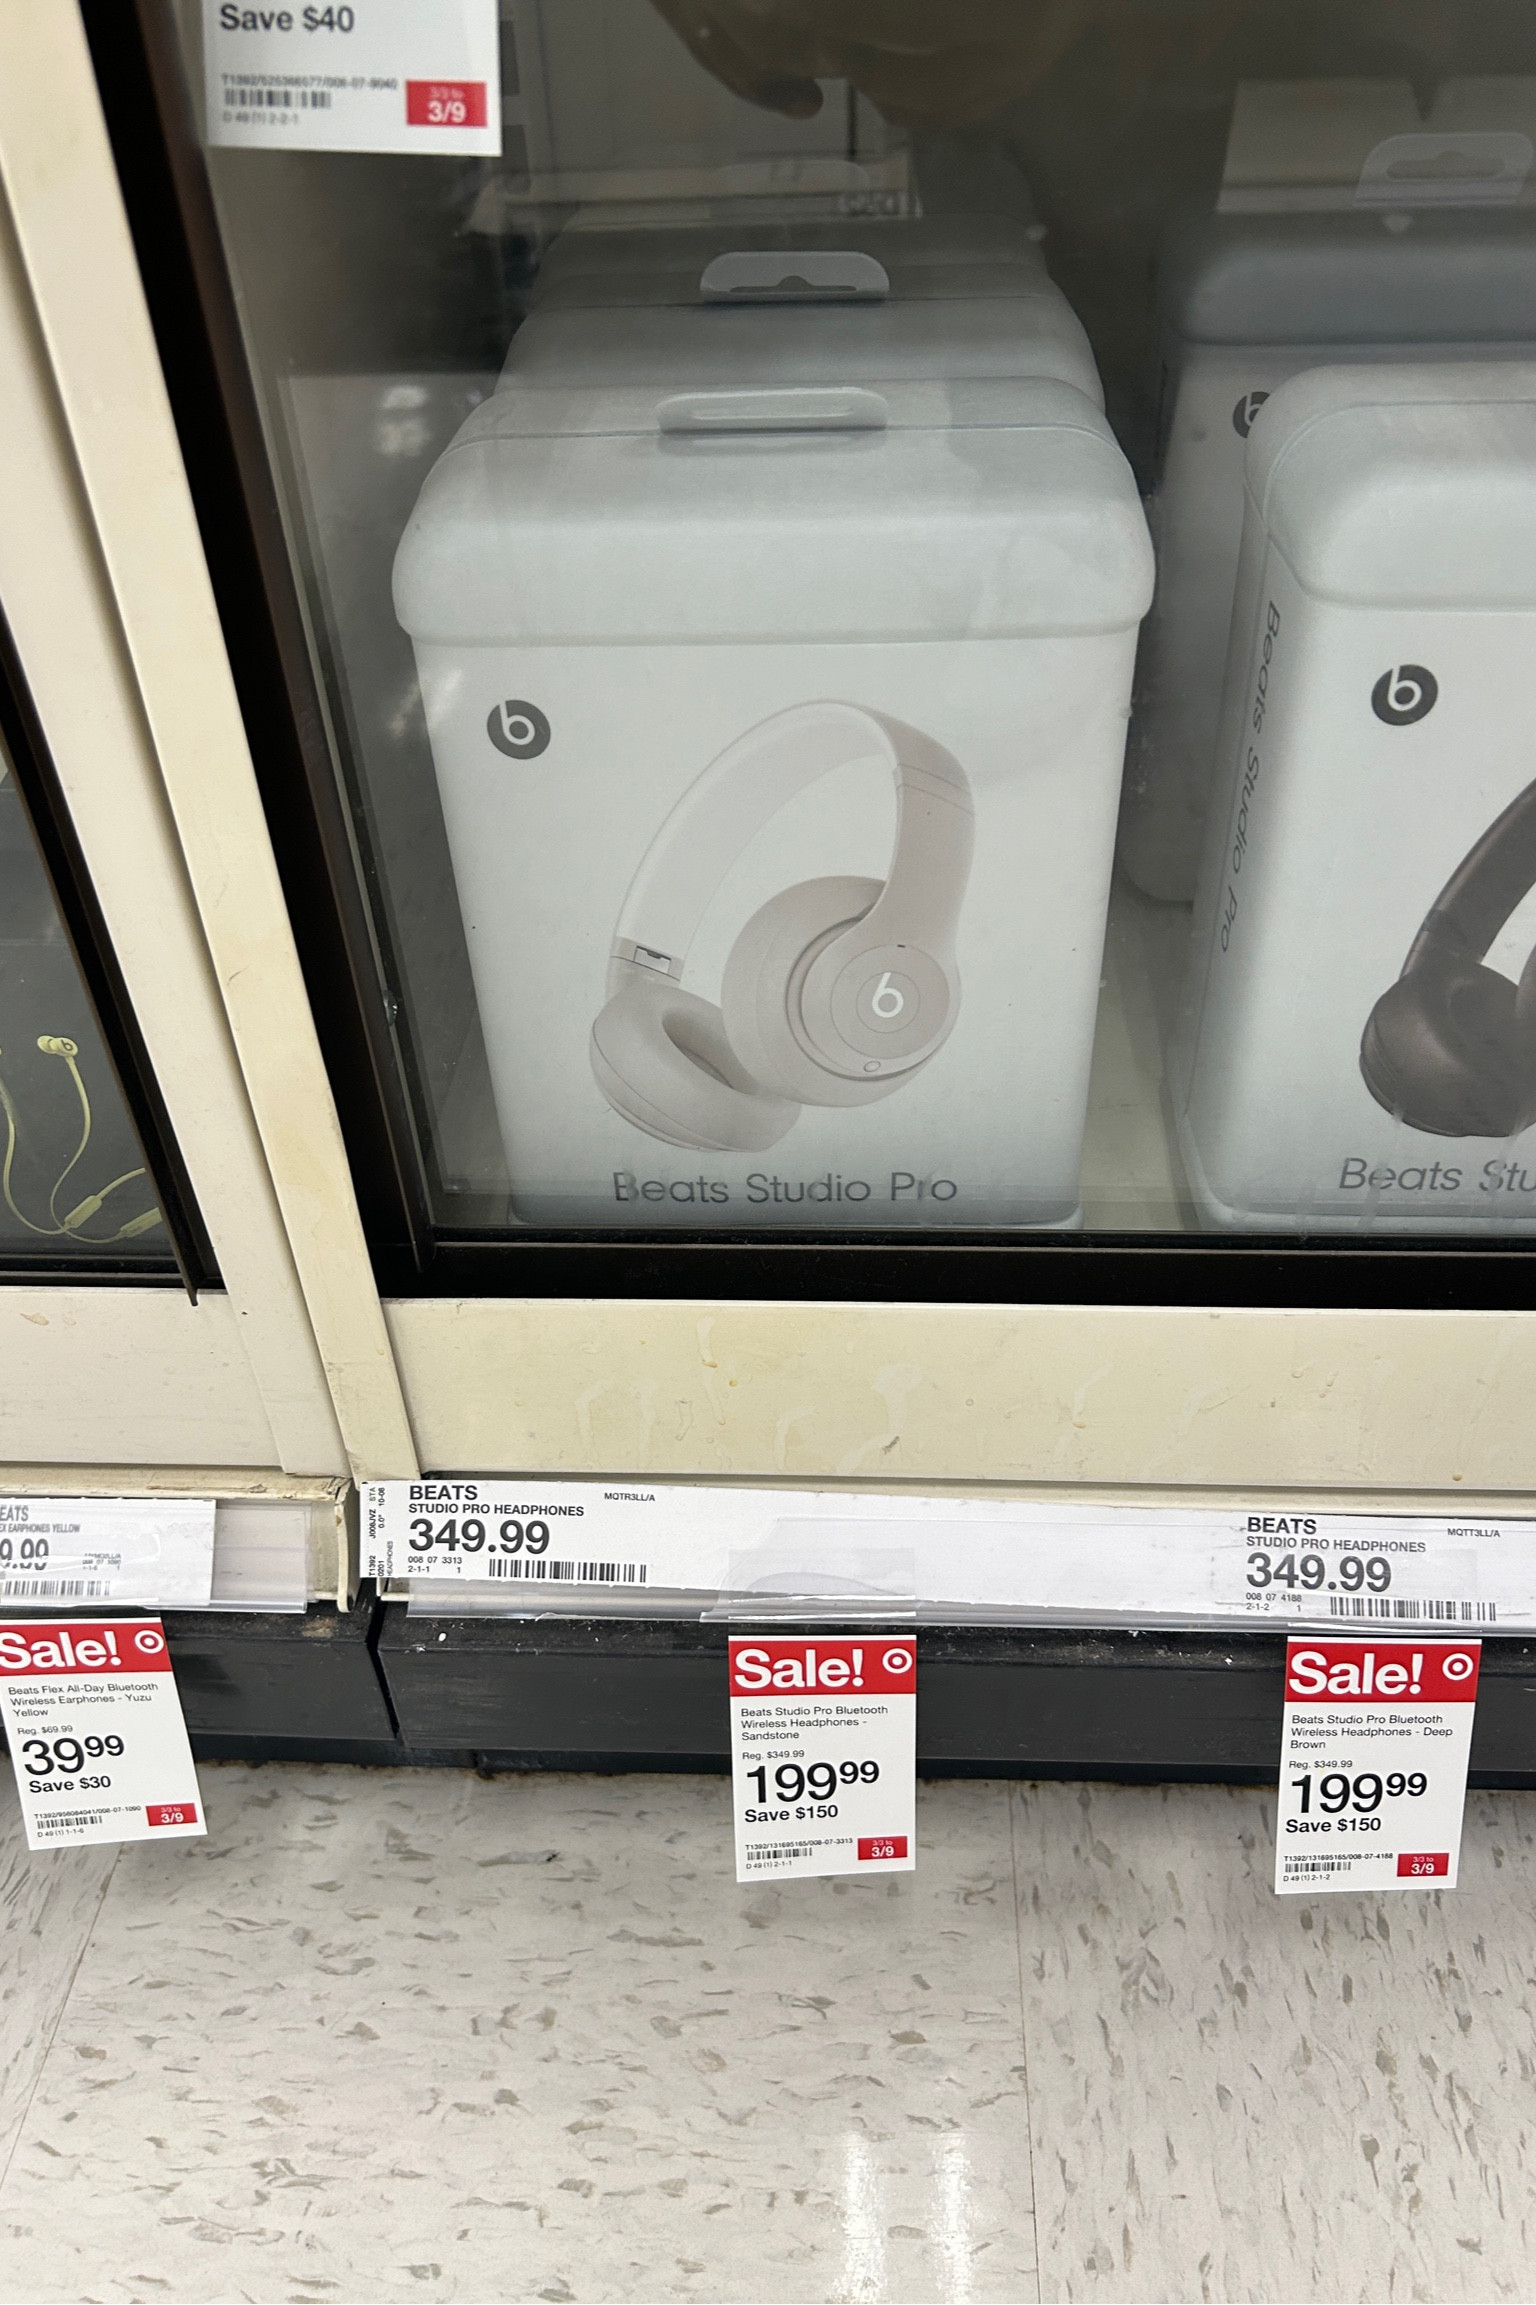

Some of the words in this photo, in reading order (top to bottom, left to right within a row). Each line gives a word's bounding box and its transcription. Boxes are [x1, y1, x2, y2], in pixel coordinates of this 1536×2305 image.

[220, 4, 293, 31] Save
[303, 5, 355, 33] $40
[427, 101, 467, 124] 3/9
[1252, 599, 1281, 734] Beats
[1232, 746, 1260, 875] Studio
[1219, 885, 1238, 952] Pro
[1339, 1157, 1463, 1191] Beats
[612, 1171, 729, 1204] Beats
[745, 1172, 871, 1204] Studio
[890, 1171, 958, 1201] Pro
[409, 1485, 478, 1500] BEATS
[603, 1492, 656, 1502] MQTR3LL/A
[408, 1503, 459, 1514] STUDIO
[462, 1503, 490, 1515] PRO
[494, 1504, 585, 1517] HEADPHONES
[8, 1523, 51, 1533] EARPHONES
[52, 1523, 81, 1533] YELLOW
[1247, 1516, 1317, 1535] BEATS
[408, 1518, 550, 1554] 349.99
[1447, 1528, 1501, 1538] MQTT3LL/A
[1246, 1536, 1297, 1549] STUDIO
[1301, 1538, 1330, 1550] PRO
[1333, 1539, 1426, 1553] HEADPHONES
[408, 1556, 424, 1564] 008
[427, 1556, 438, 1564] 07
[441, 1556, 463, 1565] 3313
[408, 1565, 430, 1573] 2-1-1
[1246, 1551, 1391, 1592] 349.99
[1246, 1592, 1262, 1601] 008
[1265, 1593, 1277, 1601] 07
[1246, 1603, 1270, 1611] 2-1-2
[0, 1630, 122, 1669] Sale!
[734, 1648, 864, 1688] Sale!
[1288, 1650, 1424, 1695] Sale!
[8, 1686, 39, 1695] Beats
[41, 1685, 64, 1694] Flex
[67, 1684, 105, 1694] All-Day
[107, 1683, 158, 1692] Bluetooth
[10, 1697, 56, 1706] Wireless
[58, 1695, 115, 1706] Earphones
[125, 1693, 152, 1702] Yuzu
[13, 1708, 49, 1717] Yellow
[741, 1708, 772, 1717] Beats
[775, 1706, 811, 1716] Studio
[813, 1706, 833, 1715] Pro
[835, 1705, 888, 1715] Bluetooth
[741, 1718, 787, 1728] Wireless
[790, 1717, 859, 1728] Headphones
[1292, 1715, 1324, 1724] Beats
[1327, 1714, 1363, 1725] Studio
[1366, 1715, 1386, 1725] Pro
[1389, 1714, 1443, 1725] Bluetooth
[17, 1727, 39, 1736] Reg.
[41, 1725, 73, 1734] $69.99
[741, 1731, 800, 1741] Sandstone
[1291, 1727, 1338, 1737] Wireless
[1341, 1727, 1412, 1738] Headphones
[1423, 1727, 1453, 1738] Deep
[1290, 1739, 1326, 1750] Brown
[742, 1751, 764, 1761] Reg.
[766, 1749, 805, 1759] $349.99
[1289, 1760, 1311, 1770] Reg.
[1314, 1759, 1353, 1769] $349.99
[29, 1779, 74, 1793] Save
[79, 1775, 111, 1790] $30
[160, 1812, 184, 1824] 3/9
[744, 1808, 790, 1823] Save
[795, 1804, 839, 1821] $150
[1285, 1818, 1332, 1833] Save
[1337, 1817, 1381, 1832] $150
[871, 1846, 895, 1858] 3/9
[1411, 1863, 1435, 1874] 3/9
